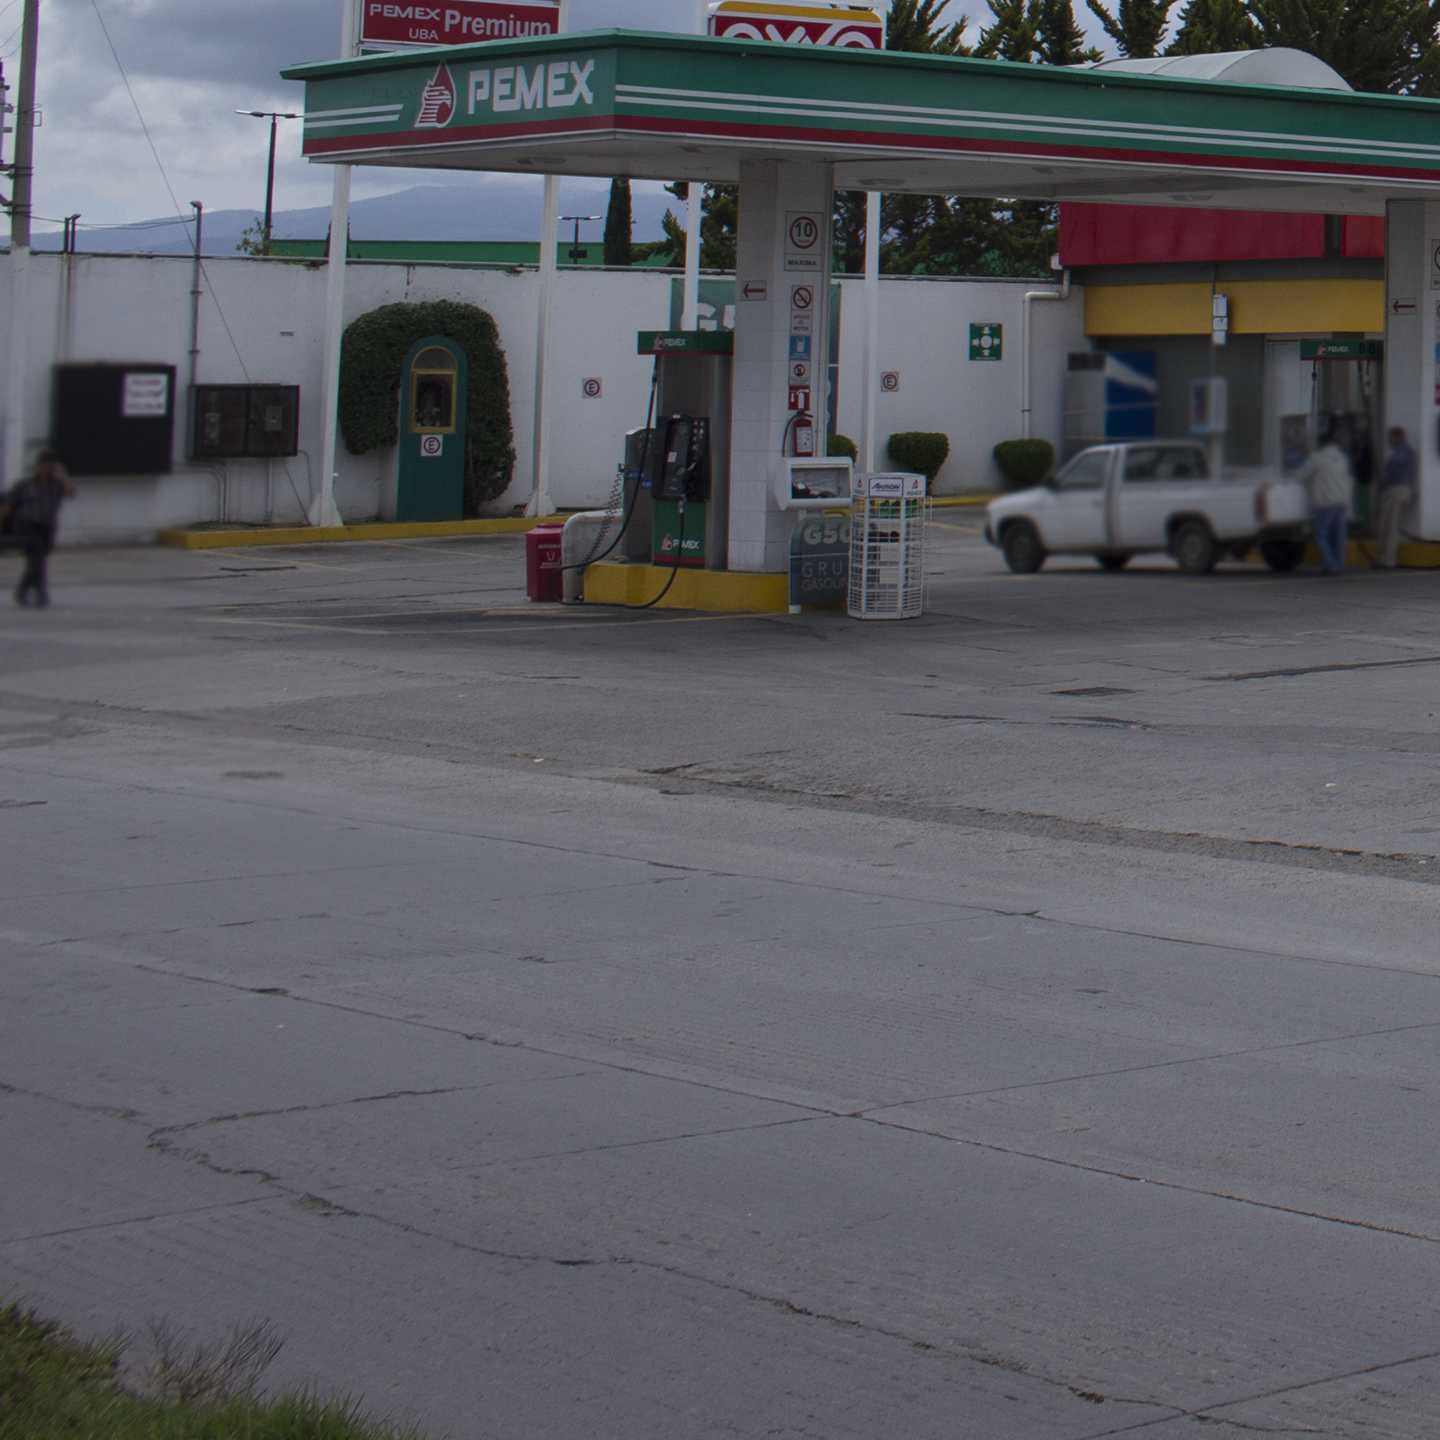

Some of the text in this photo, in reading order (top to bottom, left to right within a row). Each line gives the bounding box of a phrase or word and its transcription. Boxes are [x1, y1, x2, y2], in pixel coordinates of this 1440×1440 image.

[369, 3, 551, 37] PEMEX Premium
[408, 27, 439, 41] UBA
[467, 59, 595, 115] PEMEX
[795, 222, 813, 238] 10
[801, 560, 843, 578] GRU
